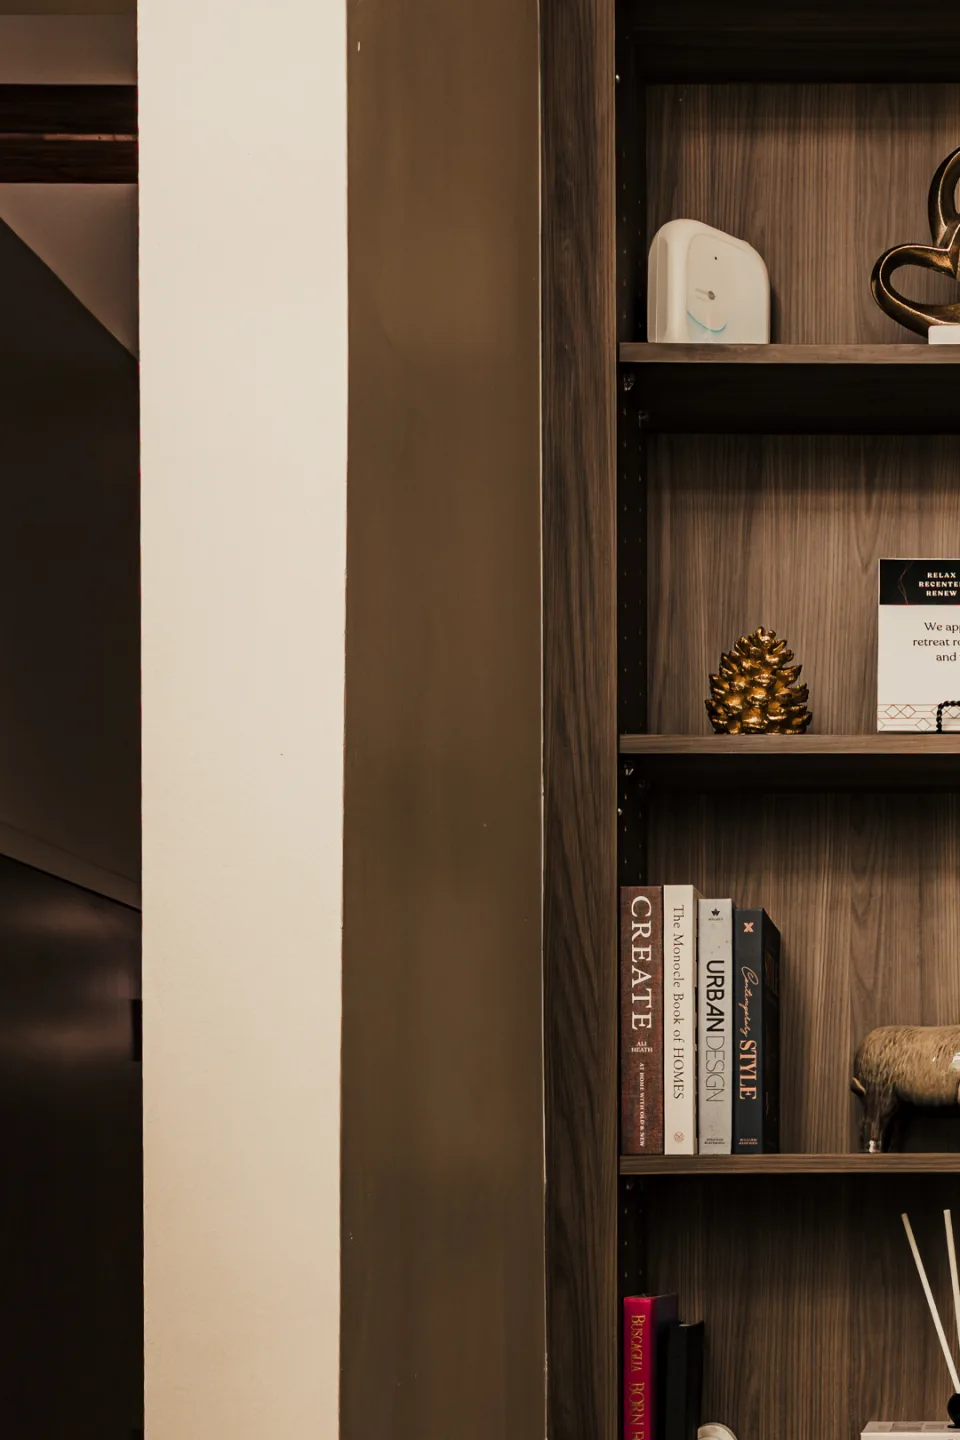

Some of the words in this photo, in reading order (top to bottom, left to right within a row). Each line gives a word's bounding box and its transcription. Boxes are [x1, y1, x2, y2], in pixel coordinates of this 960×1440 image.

[913, 638, 950, 646] retreat
[924, 622, 943, 631] We
[936, 653, 956, 661] and
[673, 905, 684, 929] The
[631, 895, 652, 1030] CREATE
[673, 934, 684, 988] Monocle
[673, 994, 684, 1024] Book
[706, 960, 725, 1032] URBAN
[740, 966, 759, 1037] Contemporary
[673, 1029, 684, 1042] of
[640, 1062, 645, 1070] AT
[673, 1047, 684, 1099] HOMES
[706, 1035, 724, 1101] DESIGN
[739, 1040, 757, 1100] STYLE
[629, 1382, 645, 1425] BORN
